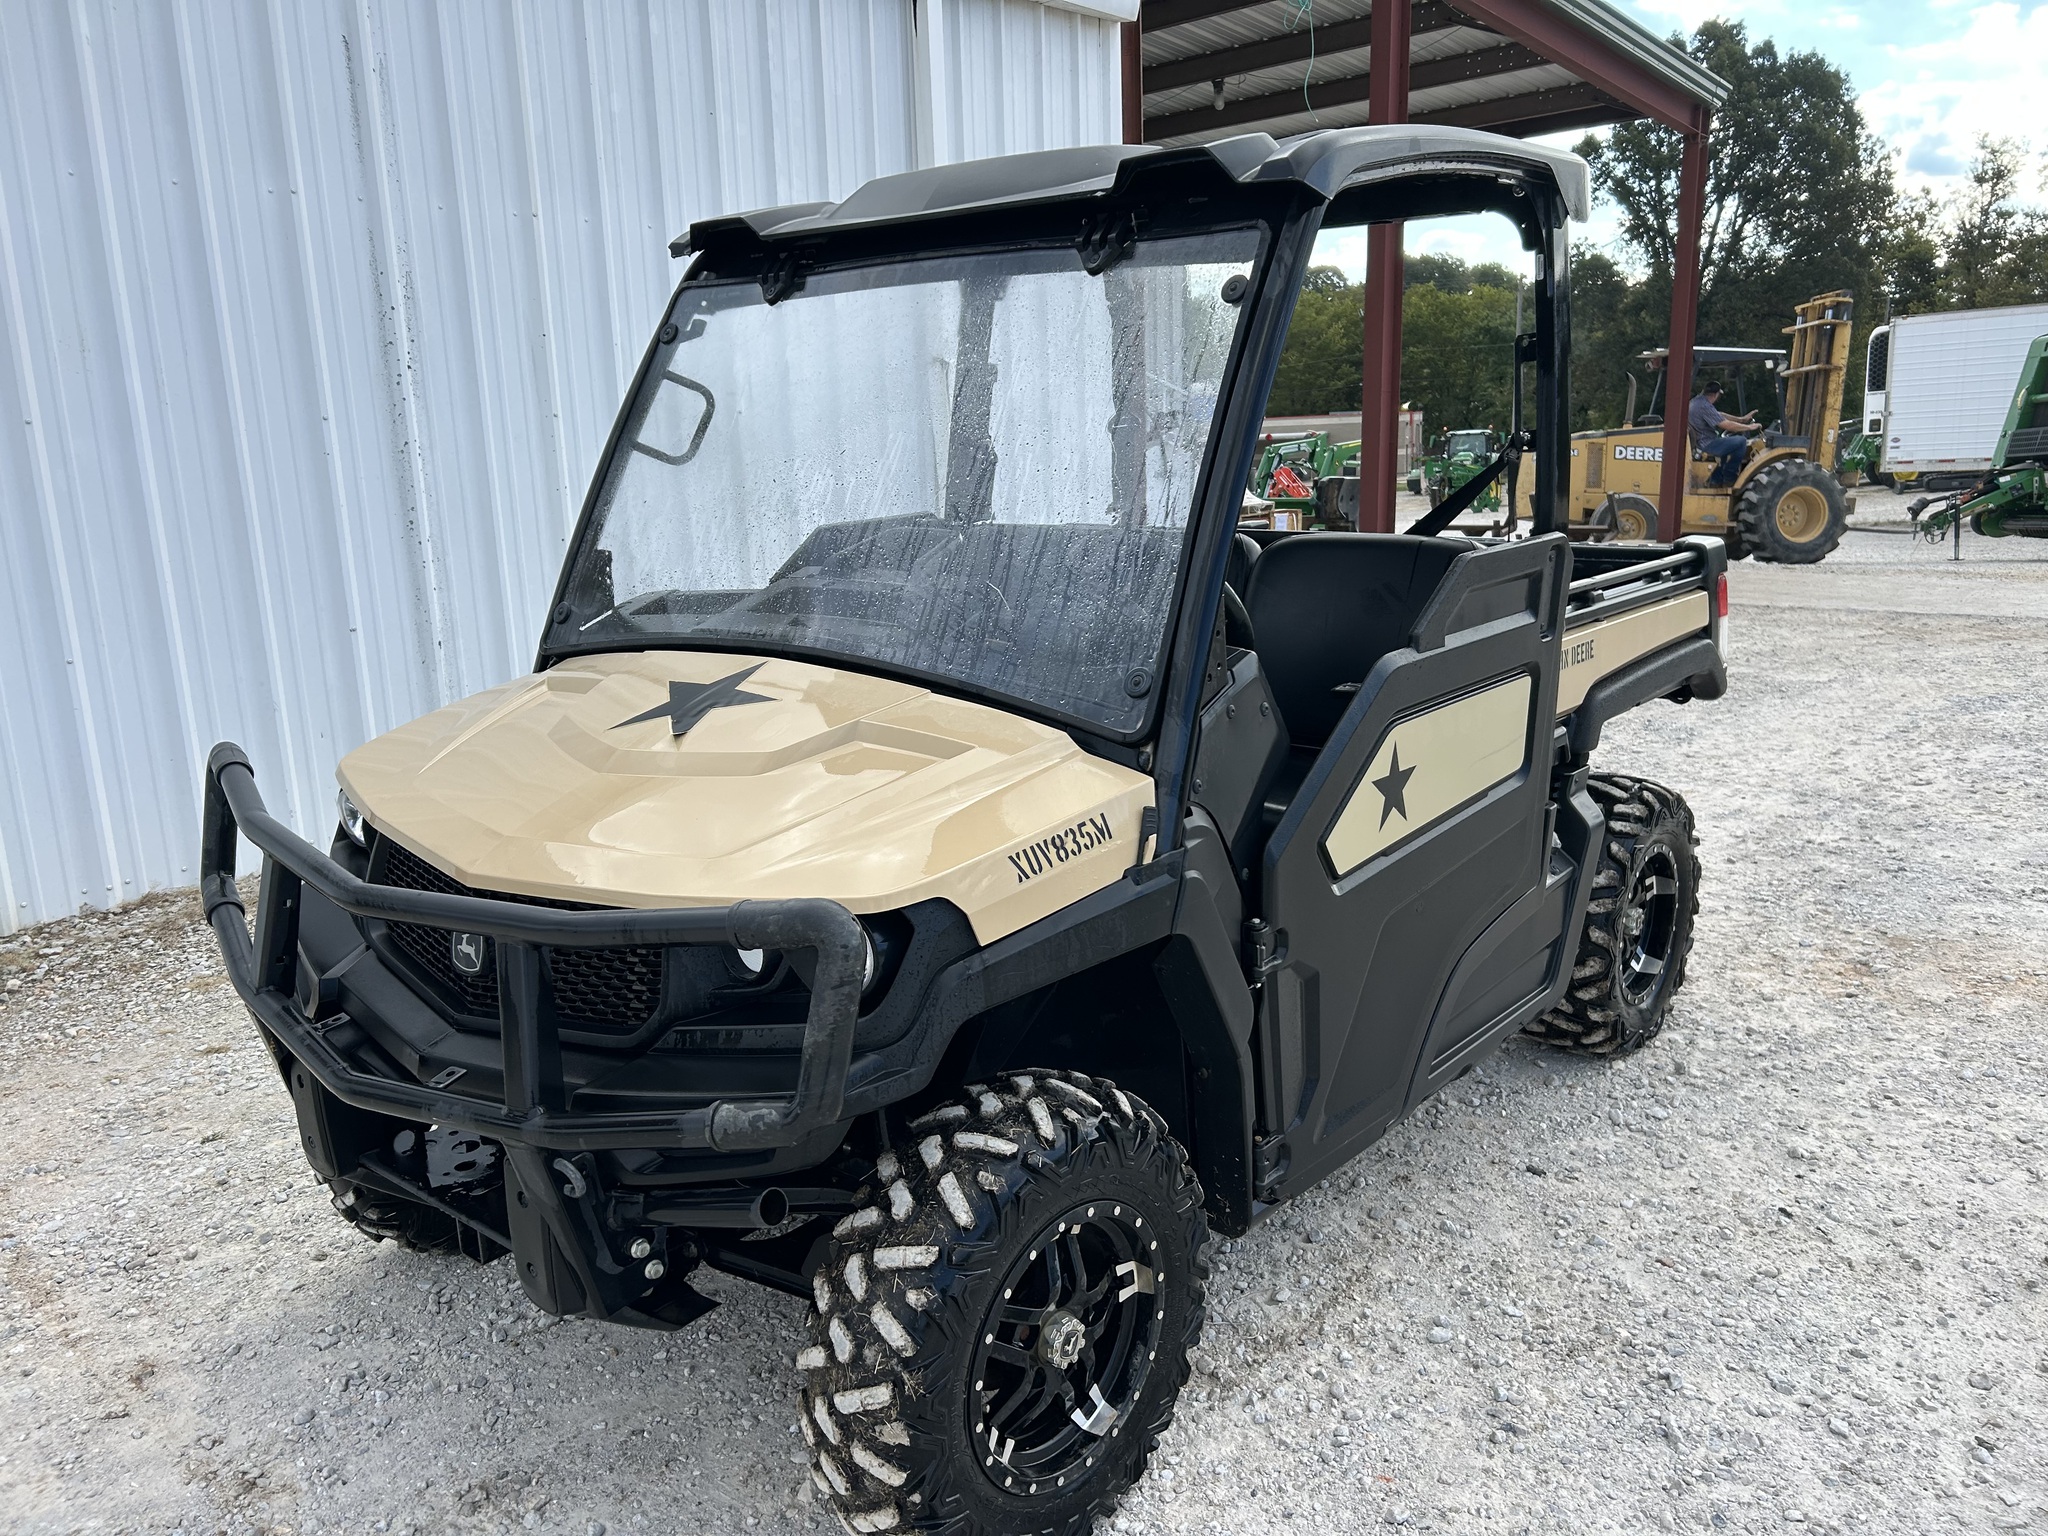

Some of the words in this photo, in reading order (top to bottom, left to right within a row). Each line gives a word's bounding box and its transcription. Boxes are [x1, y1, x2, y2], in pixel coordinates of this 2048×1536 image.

[1614, 445, 1663, 462] DEERE
[1571, 639, 1594, 666] DEERE
[1007, 812, 1113, 884] XUV835M
